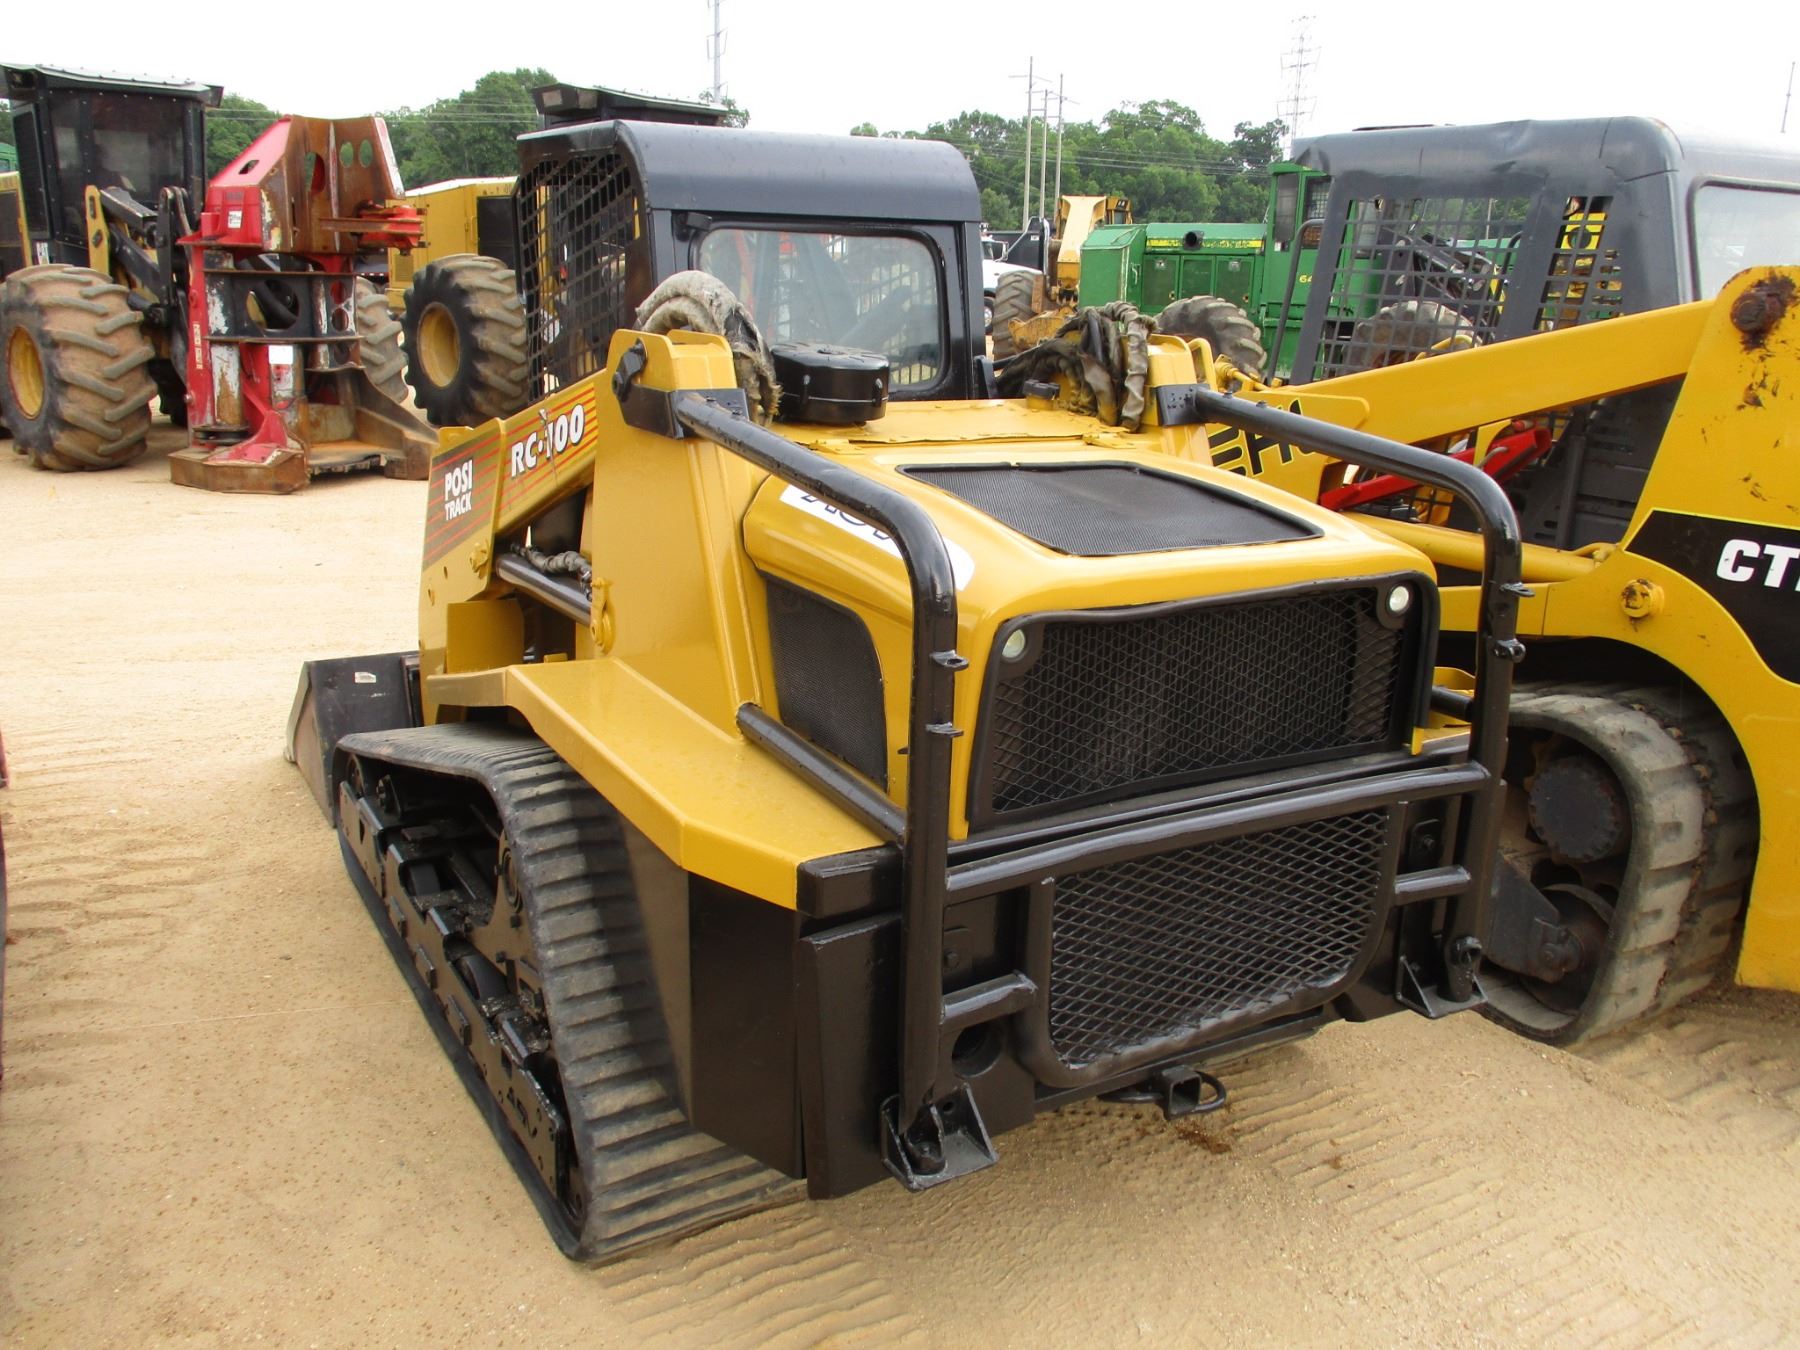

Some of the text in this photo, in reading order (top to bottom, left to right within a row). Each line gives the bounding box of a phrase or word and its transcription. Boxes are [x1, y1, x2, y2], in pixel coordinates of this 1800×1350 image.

[444, 459, 473, 501] POSI
[444, 492, 472, 521] TRACK
[1716, 538, 1800, 593] CT
